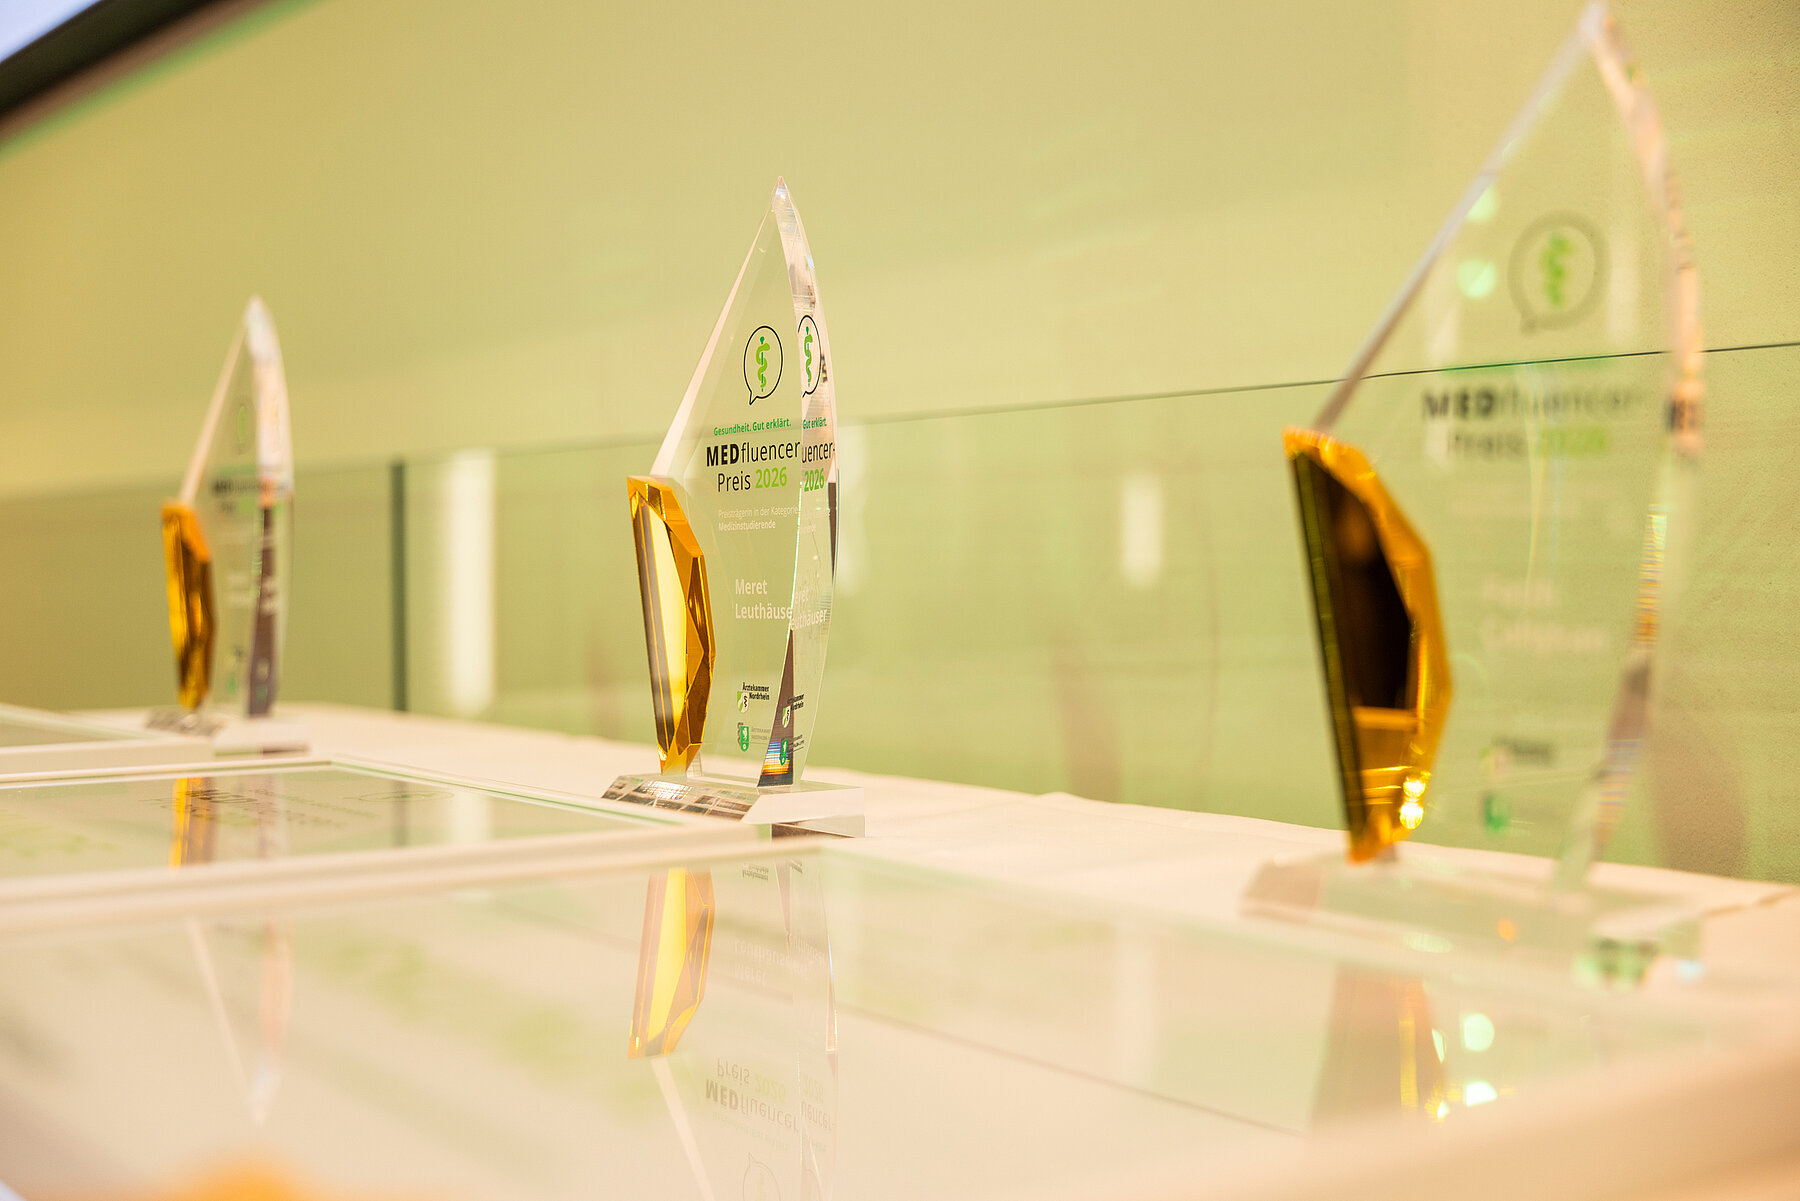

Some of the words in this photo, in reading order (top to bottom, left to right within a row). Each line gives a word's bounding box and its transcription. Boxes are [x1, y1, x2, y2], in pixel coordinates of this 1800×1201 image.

[713, 422, 751, 436] Gesundheit.
[752, 421, 765, 432] Gut
[766, 418, 792, 430] erklärt.
[706, 441, 801, 467] MEDfluencer
[717, 470, 751, 493] Preis
[755, 466, 788, 489] 2026
[804, 468, 825, 492] 2026
[760, 507, 770, 516] der
[718, 519, 776, 531] Medizinstudierende
[735, 578, 768, 595] Meret
